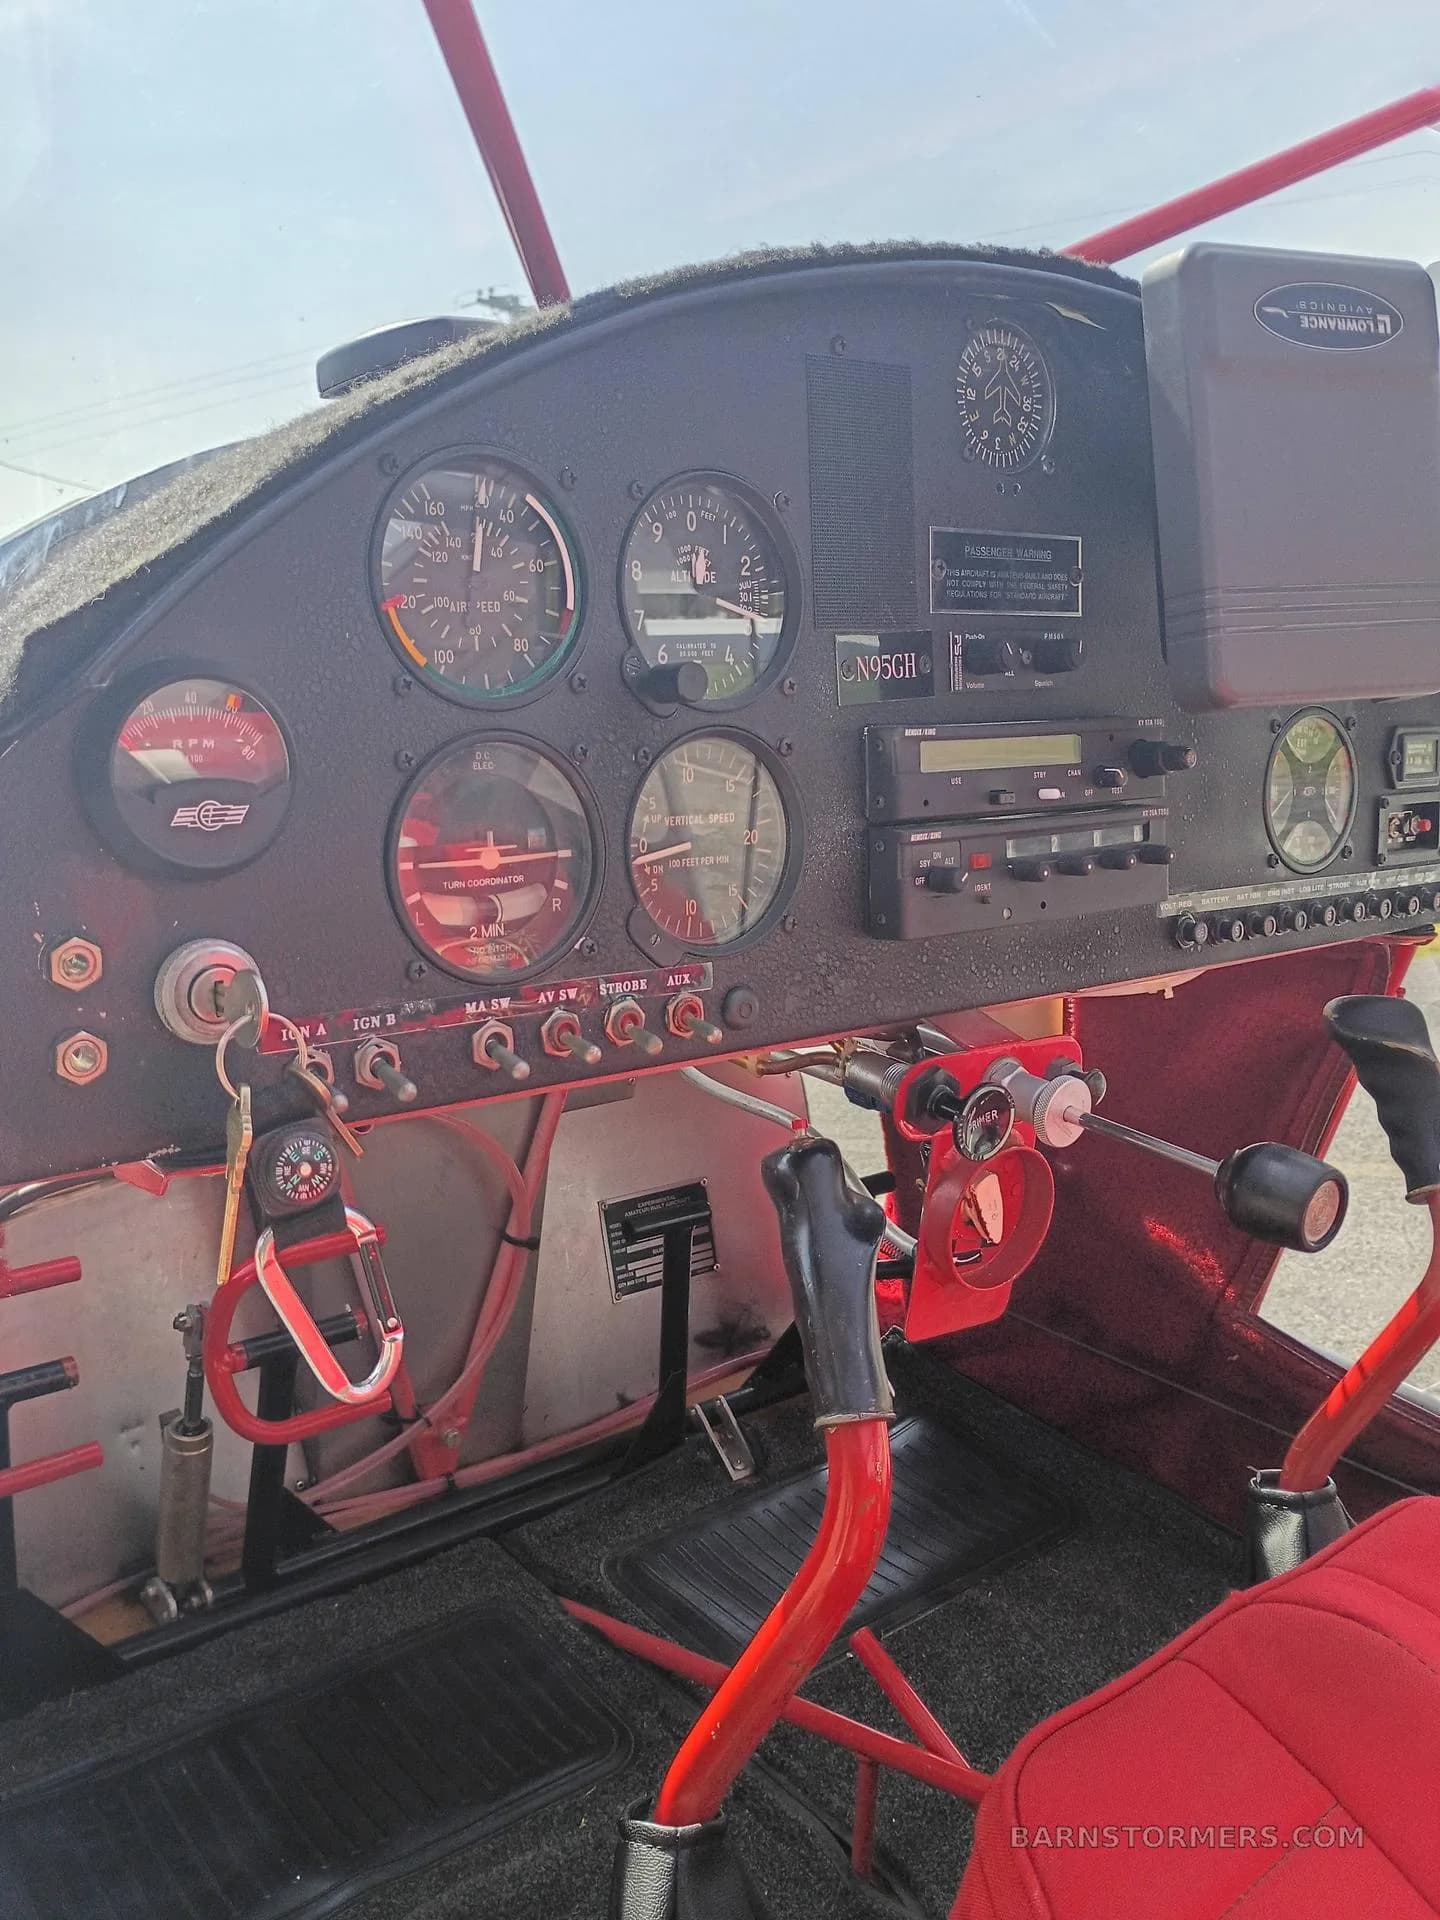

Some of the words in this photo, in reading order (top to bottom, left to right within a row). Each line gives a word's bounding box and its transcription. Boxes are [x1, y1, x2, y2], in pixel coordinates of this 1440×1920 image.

[1299, 301, 1372, 314] AVIONICS
[1300, 315, 1374, 333] LOWRANCE
[967, 389, 976, 400] 12
[1023, 396, 1031, 411] 30
[970, 410, 979, 422] E
[1018, 416, 1028, 433] 33
[995, 437, 1001, 450] 3
[425, 502, 444, 515] 160
[500, 510, 514, 524] 40
[687, 511, 696, 531] 0
[701, 511, 716, 522] FEET
[402, 528, 423, 540] 140
[652, 522, 663, 543] 9
[723, 524, 727, 544] 1
[445, 537, 462, 548] 140
[491, 548, 503, 558] 40
[678, 545, 691, 554] 1000
[964, 545, 1013, 558] PASSENGER
[1016, 549, 1052, 560] WARNING
[432, 552, 448, 563] 120
[529, 561, 544, 572] 60
[632, 561, 642, 581] 8
[741, 555, 751, 576] 2
[671, 571, 717, 584] ALTIDE
[961, 569, 990, 578] AIRCRAFT
[434, 597, 449, 608] 100
[504, 591, 515, 601] 60
[739, 593, 752, 602] 30.1
[635, 610, 644, 631] 7
[514, 638, 528, 651] 80
[434, 649, 454, 663] 100
[658, 644, 668, 664] 6
[725, 646, 734, 666] 4
[856, 653, 916, 682] N95GH
[185, 693, 196, 704] 40
[141, 702, 154, 715] 20
[241, 745, 255, 760] 80
[682, 768, 694, 782] 10
[1034, 771, 1046, 779] STBY
[1068, 769, 1081, 777] CHAN
[726, 780, 736, 792] 15
[951, 777, 962, 785] USE
[1085, 789, 1093, 797] OFF
[650, 798, 656, 810] 5
[652, 814, 662, 824] UP
[664, 815, 704, 826] VERTICAL
[709, 814, 735, 824] SPEED
[744, 830, 758, 845] 20
[639, 839, 647, 853] 0
[669, 859, 680, 868] 100
[681, 857, 699, 867] FEET
[701, 856, 714, 866] PER
[716, 856, 729, 864] MIN
[653, 865, 663, 874] DN
[443, 880, 466, 890] TURN
[467, 875, 525, 887] COORDINATOR
[651, 879, 658, 891] 5
[915, 877, 925, 885] OFF
[975, 883, 991, 892] IDENT
[729, 884, 737, 896] 15
[552, 898, 562, 912] R
[1160, 902, 1176, 910] VOLT
[1202, 896, 1230, 905] BATTERY
[685, 900, 696, 915] 10
[416, 911, 424, 926] L
[469, 926, 479, 939] 2
[666, 974, 691, 986] AUX
[600, 979, 648, 995] STROBE
[538, 991, 555, 1004] AV
[559, 988, 578, 1000] SW
[465, 1001, 489, 1014] MA
[491, 997, 511, 1010] SW
[353, 1016, 381, 1031] IGN
[386, 1013, 396, 1026] B
[317, 1023, 327, 1036] A
[968, 1109, 998, 1131] PRIMER
[289, 1152, 300, 1162] E
[314, 1151, 323, 1160] S
[290, 1174, 300, 1185] N
[311, 1174, 323, 1187] W
